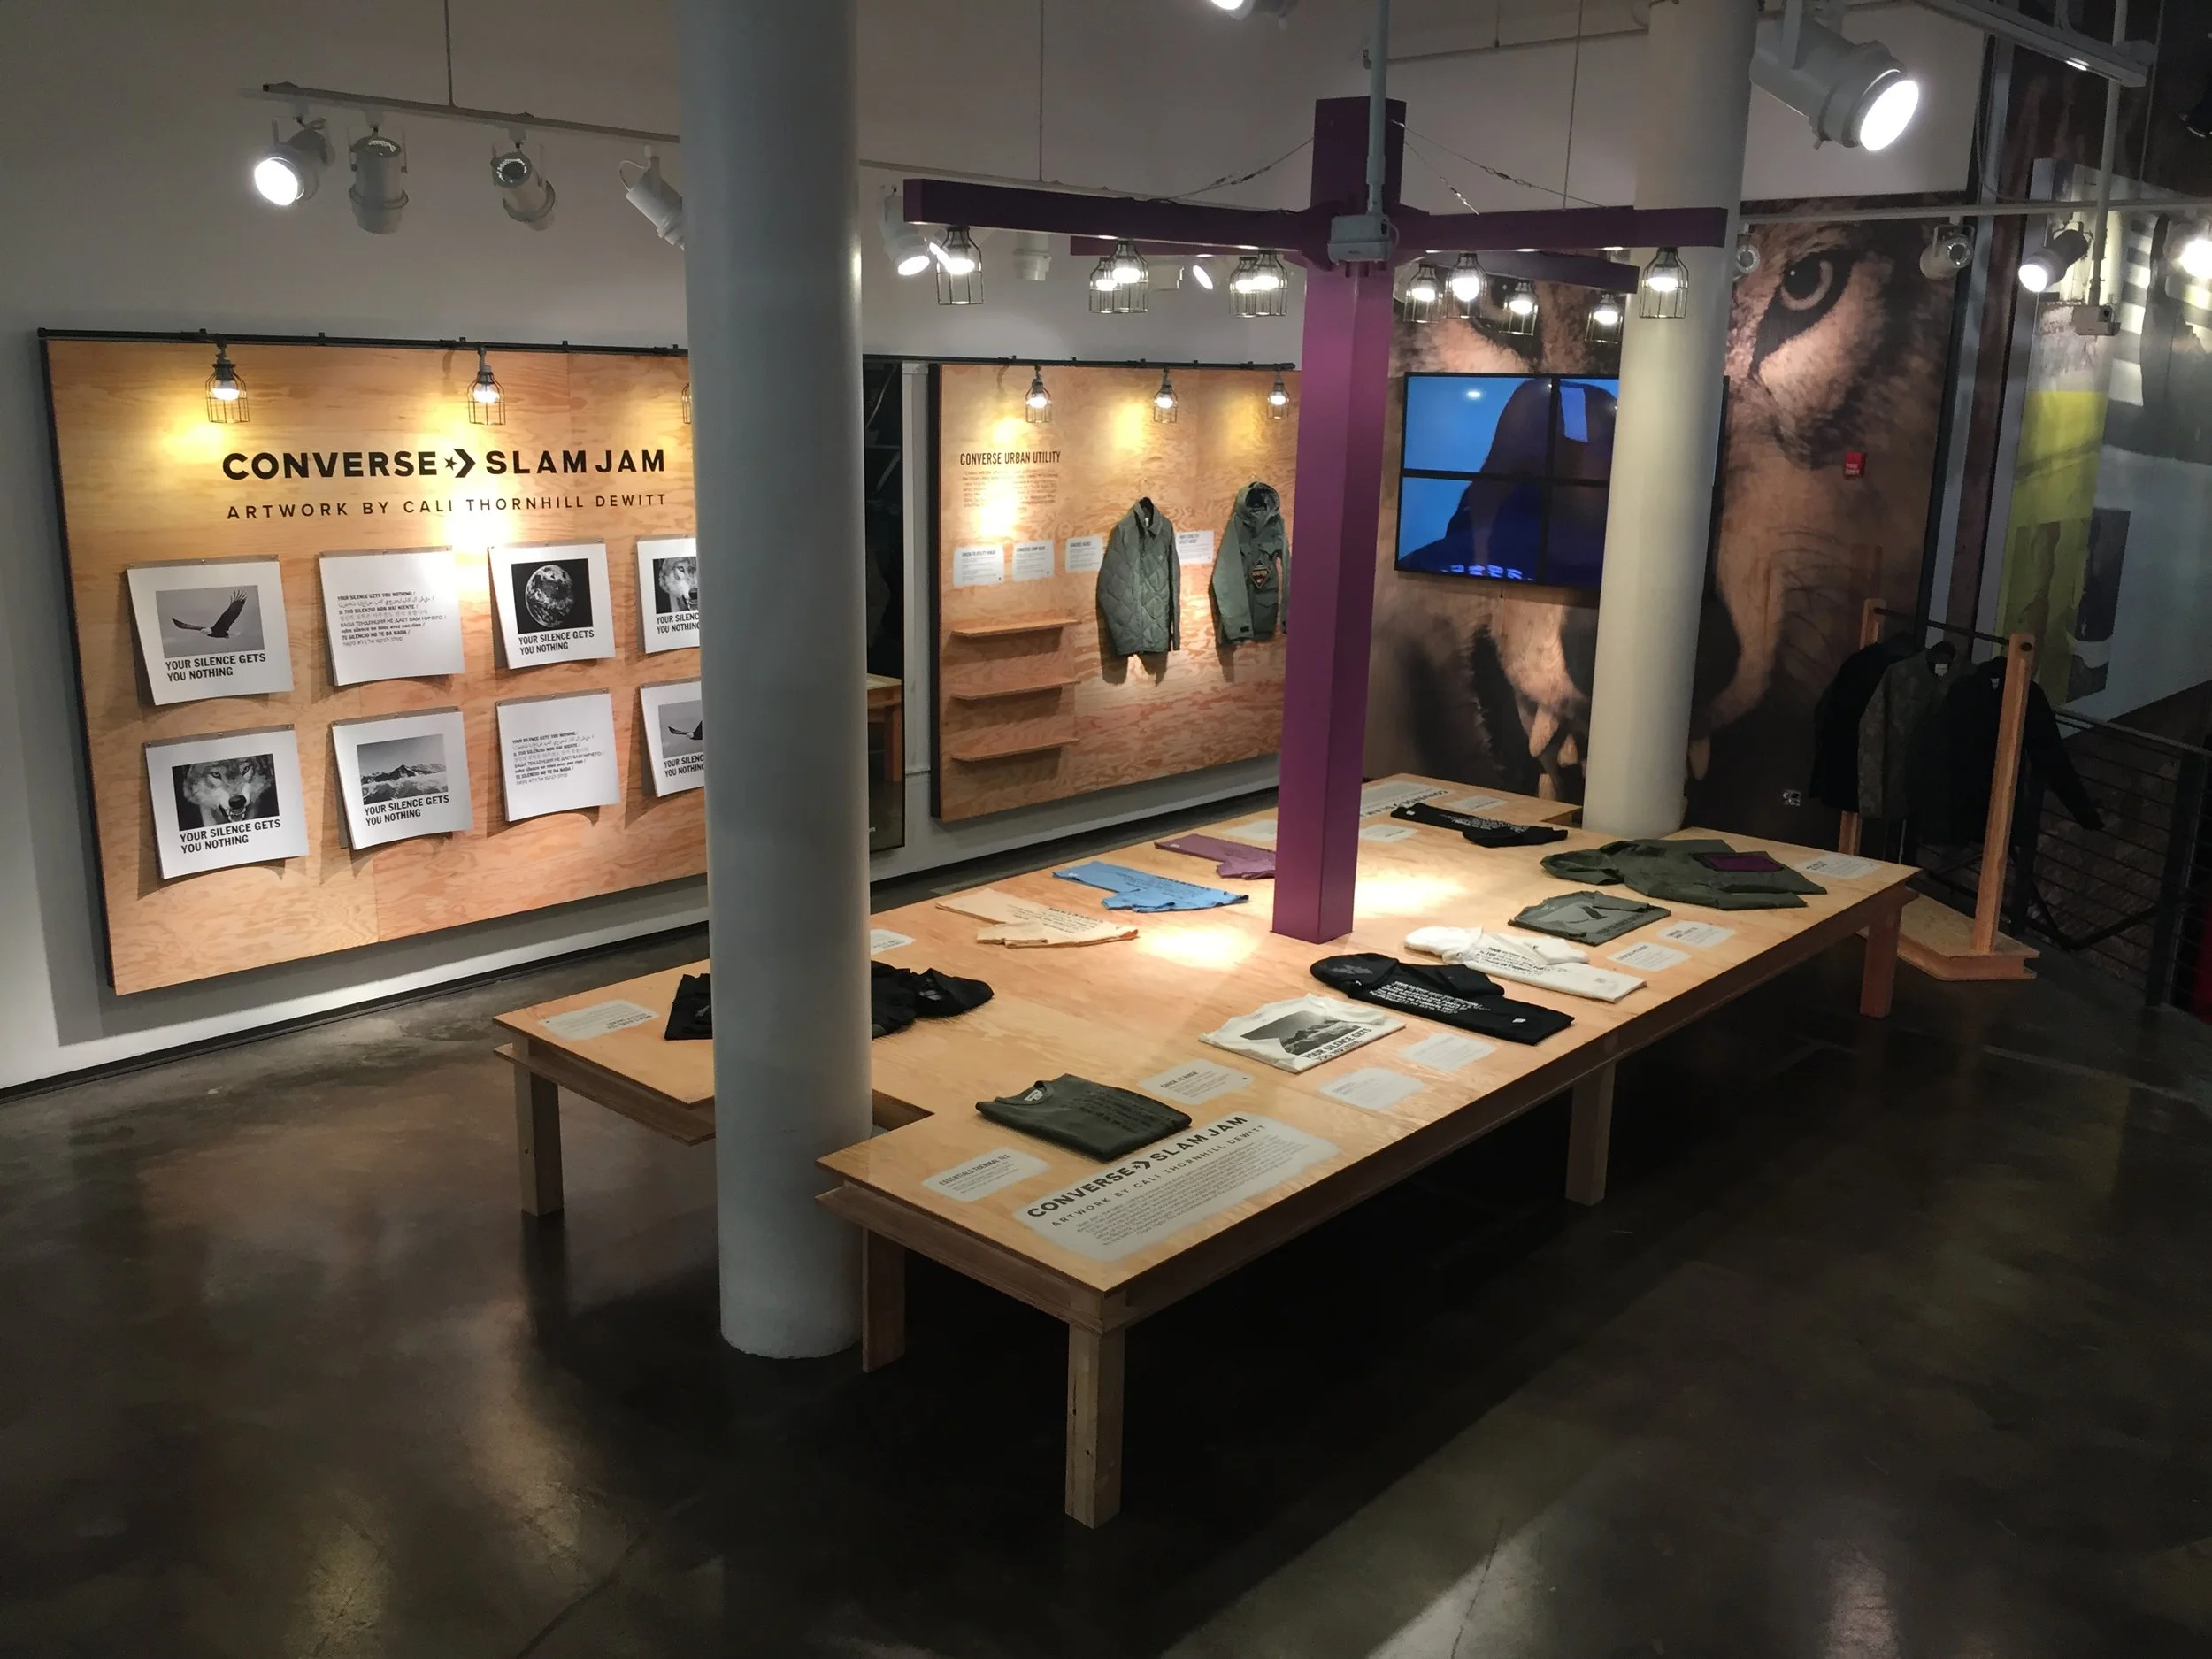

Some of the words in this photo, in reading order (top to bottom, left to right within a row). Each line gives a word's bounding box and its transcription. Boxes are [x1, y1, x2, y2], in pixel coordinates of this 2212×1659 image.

[222, 450, 438, 480] CONVERSE
[486, 449, 587, 475] SLAM
[595, 449, 665, 473] JAM
[960, 452, 1002, 465] CONVERSE
[1004, 451, 1031, 464] URBAN
[1033, 450, 1061, 463] UTILITY
[227, 503, 348, 519] ARTWORK
[363, 501, 389, 515] BY
[403, 499, 452, 513] CALI
[465, 495, 584, 511] THORNHILL
[595, 494, 666, 508] DEWITT
[656, 615, 673, 625] YOUR
[675, 612, 699, 623] SILENC
[518, 635, 538, 645] YOUR
[540, 632, 571, 642] SILENCE
[572, 630, 595, 639] GETS
[657, 625, 670, 634] YOU
[519, 646, 534, 656] YOU
[536, 641, 569, 653] NOTHING
[165, 659, 191, 671] YOUR
[194, 655, 236, 667] SILENCE
[238, 653, 266, 664] GETS
[167, 672, 187, 682] YOU
[188, 667, 234, 680] NOTHING
[664, 758, 680, 768] YOUR
[681, 754, 704, 764] SILENC
[364, 804, 387, 816] YOUR
[388, 798, 423, 811] SILENCE
[426, 795, 449, 805] GETS
[365, 816, 382, 826] YOU
[384, 809, 421, 823] NOTHING
[180, 830, 208, 842] YOUR
[210, 823, 251, 838] SILENCE
[254, 818, 281, 831] GETS
[181, 842, 202, 854] YOU
[204, 834, 249, 849] NOTHING
[1027, 1167, 1135, 1217] CONVERSE
[1150, 1133, 1209, 1161] SLAM
[1208, 1116, 1248, 1137] JAM
[1051, 1198, 1111, 1227] ARTWORK
[1113, 1188, 1131, 1198] BY
[1133, 1174, 1161, 1188] CALI
[1164, 1145, 1225, 1174] THORNHILL
[1227, 1125, 1266, 1145] DEWITT
